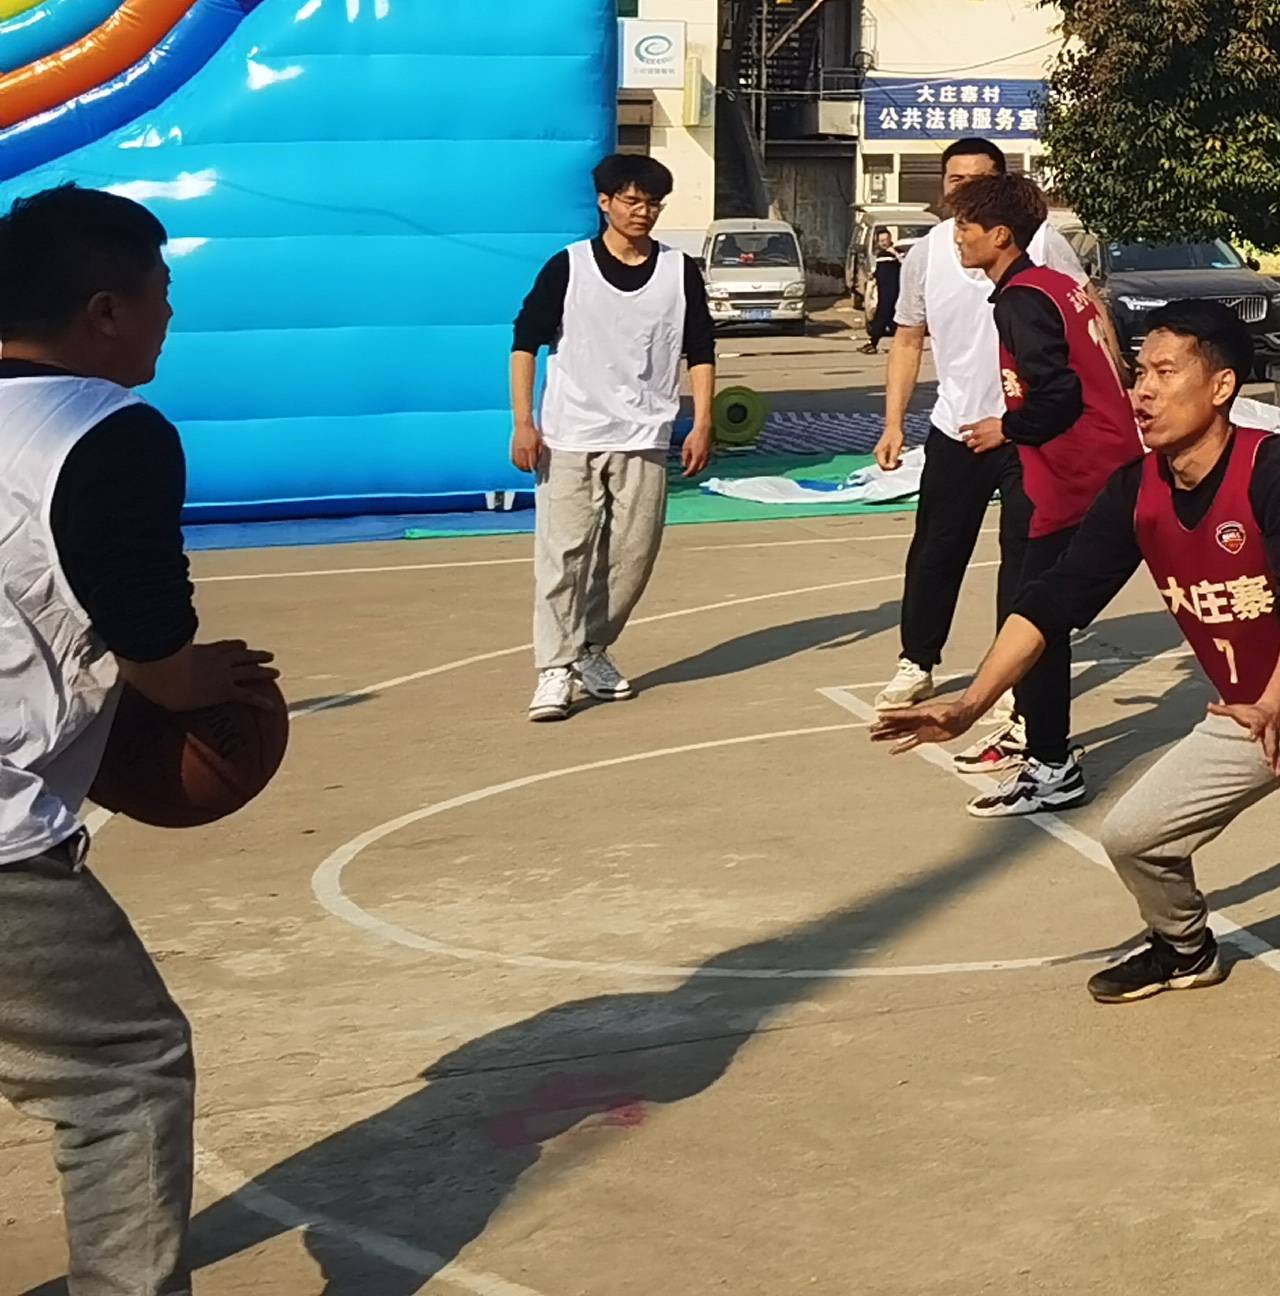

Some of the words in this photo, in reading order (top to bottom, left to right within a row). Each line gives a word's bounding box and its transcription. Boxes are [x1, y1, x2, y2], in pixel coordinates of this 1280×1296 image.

[916, 85, 1001, 104] 大庄寨村
[878, 107, 1039, 131] 公共法律服务室
[1161, 575, 1276, 624] 大庄寨
